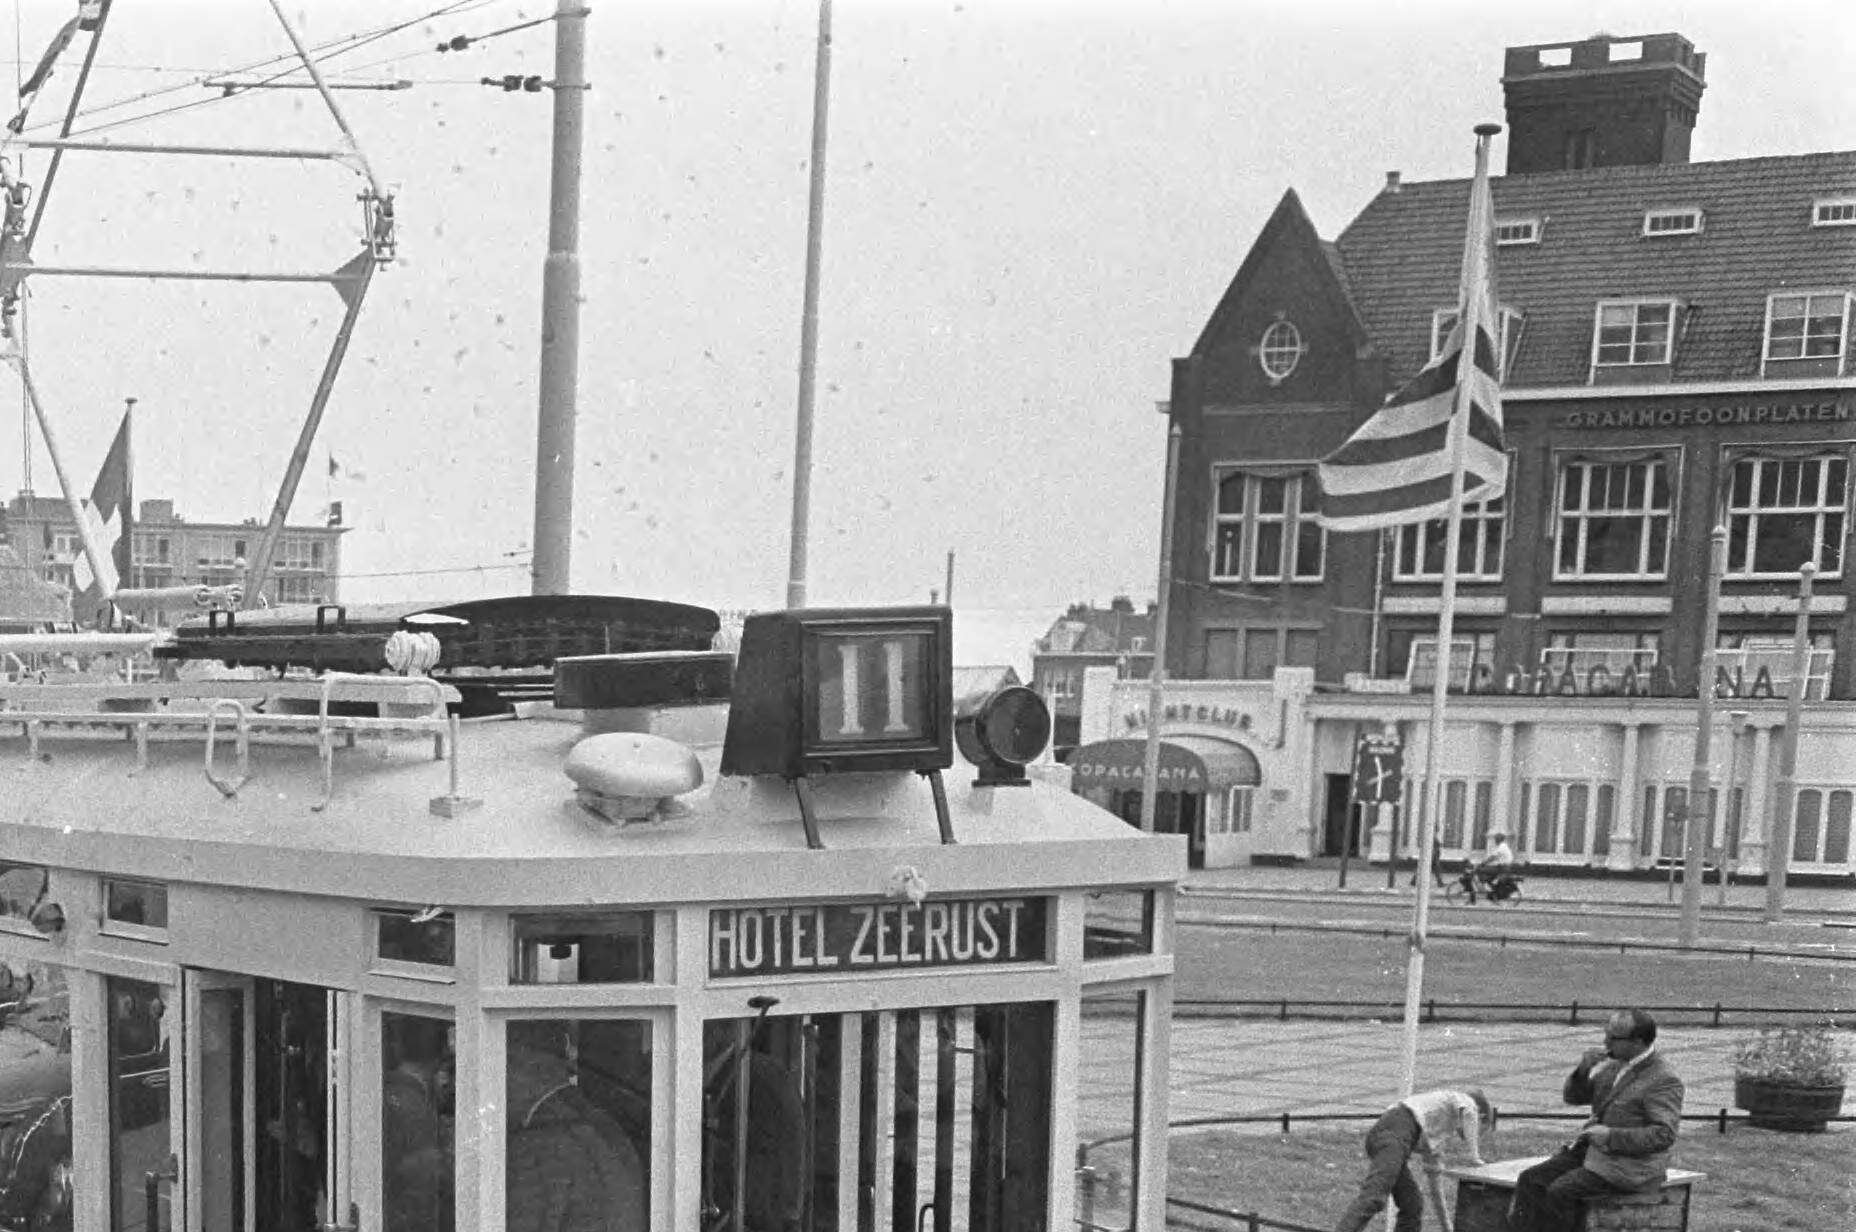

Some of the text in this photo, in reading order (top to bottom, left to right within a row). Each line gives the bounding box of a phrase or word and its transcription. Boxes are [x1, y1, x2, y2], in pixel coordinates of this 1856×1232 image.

[1567, 403, 1848, 427] GRAMMOFOONPLATEN
[837, 640, 911, 734] 11
[1124, 704, 1252, 730] NIHTCLUB
[711, 900, 1025, 970] HOTEL ZEERUST
